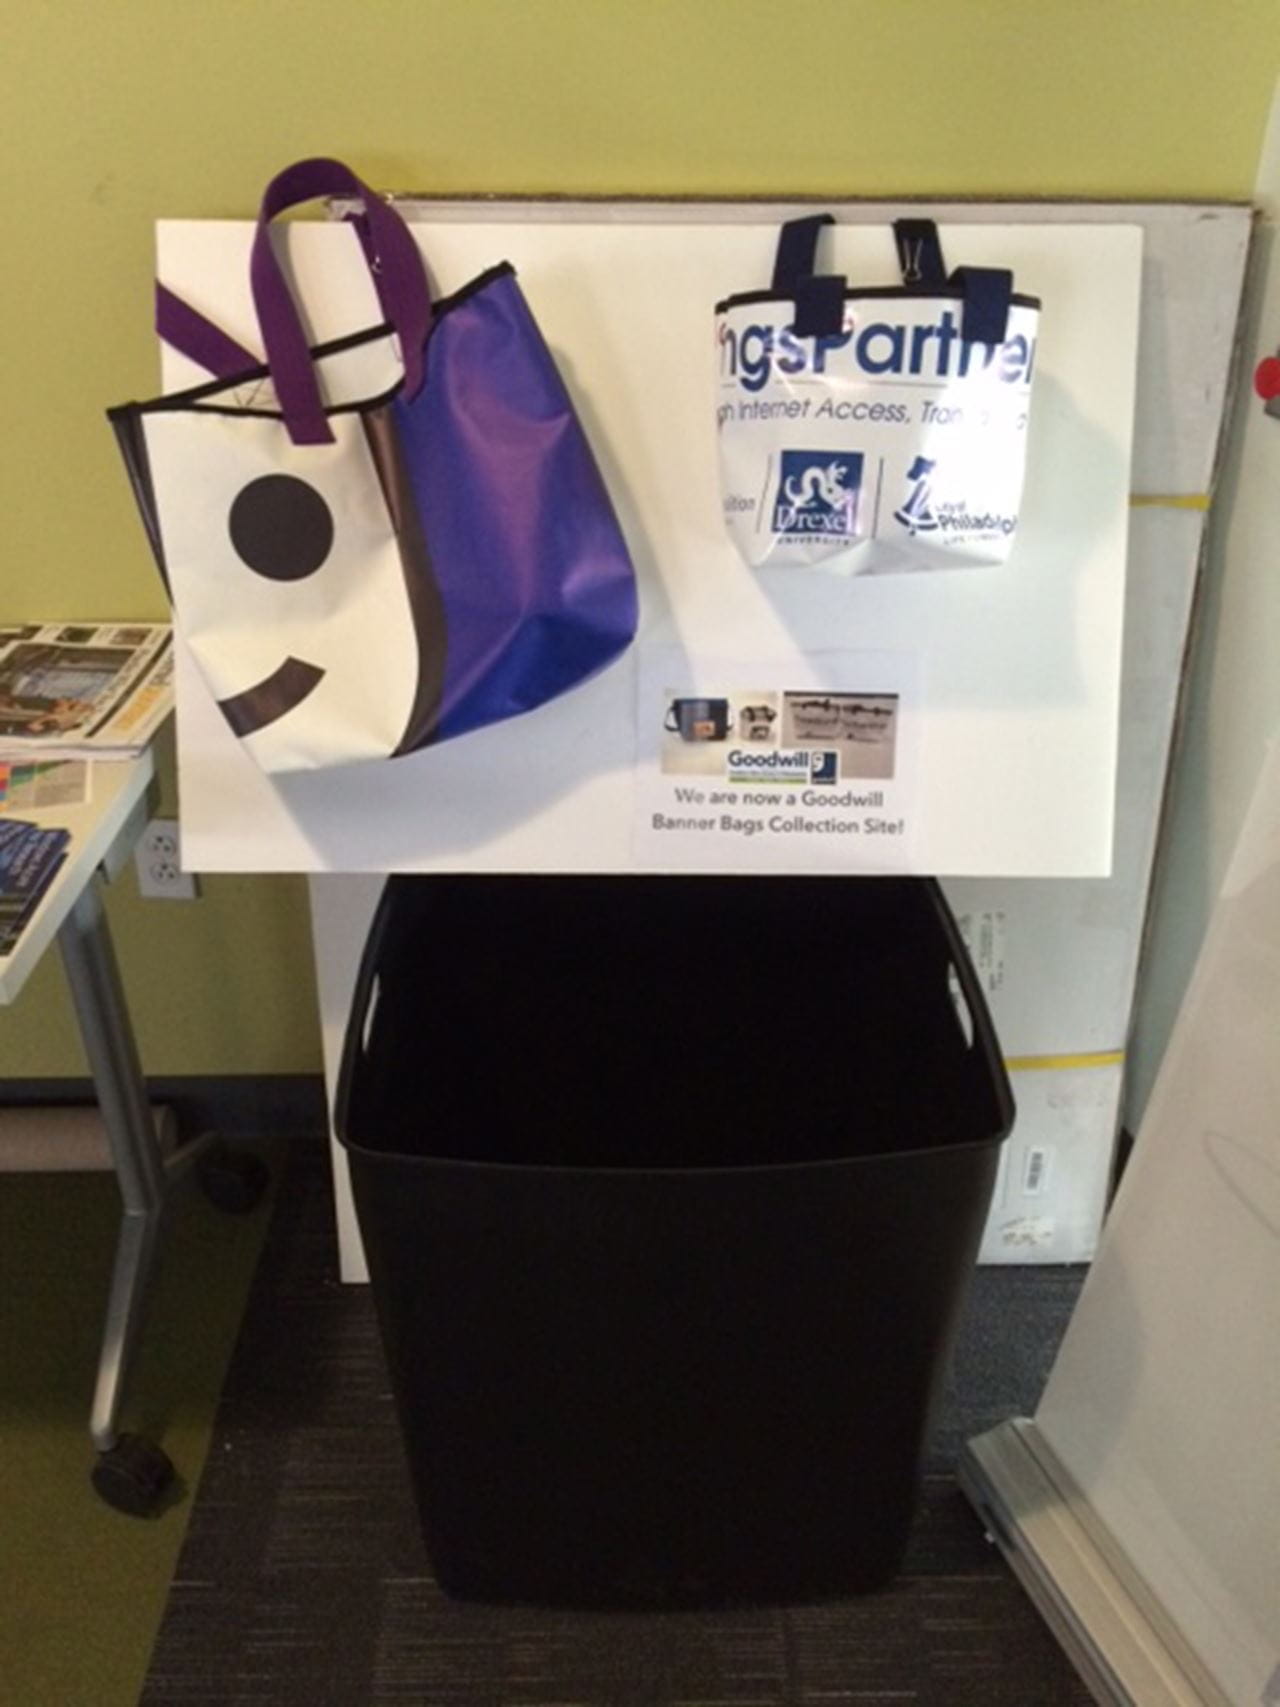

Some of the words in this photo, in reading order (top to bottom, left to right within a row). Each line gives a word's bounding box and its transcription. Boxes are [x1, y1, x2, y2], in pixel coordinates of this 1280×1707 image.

[739, 398, 811, 419] Internet
[815, 398, 911, 424] Access,
[776, 505, 853, 532] Drexel
[728, 750, 809, 767] Goodwill
[675, 787, 704, 802] We
[709, 791, 738, 805] are
[743, 792, 781, 806] now
[786, 793, 796, 806] a
[801, 789, 884, 807] Goodwill
[652, 814, 715, 831] Banner
[720, 815, 764, 835] Bags
[769, 816, 859, 834] Collection
[864, 818, 904, 835] Site!
